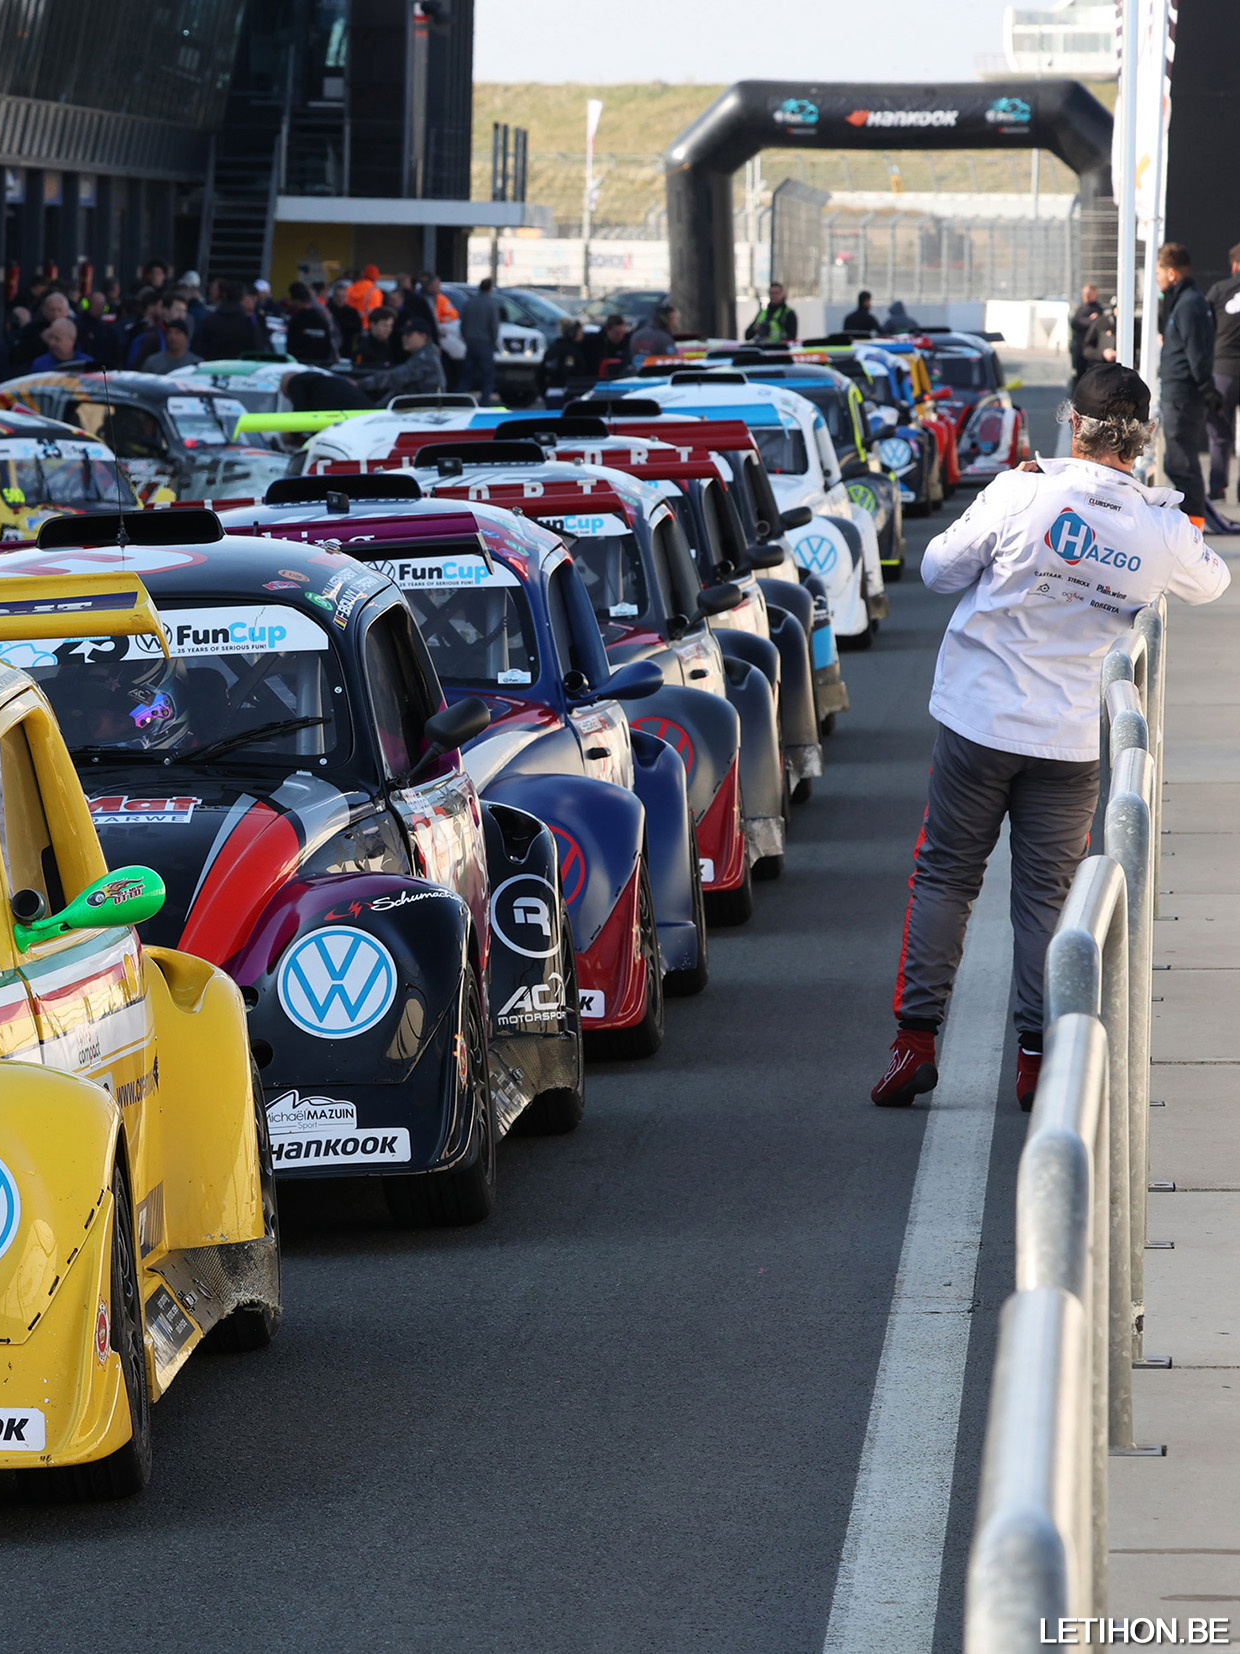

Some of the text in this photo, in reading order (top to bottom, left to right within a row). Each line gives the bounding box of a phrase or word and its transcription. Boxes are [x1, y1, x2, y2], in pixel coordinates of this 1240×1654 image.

[1088, 498, 1122, 512] CLUBSPORT
[177, 622, 287, 648] FunCup
[297, 1121, 318, 1130] Sport
